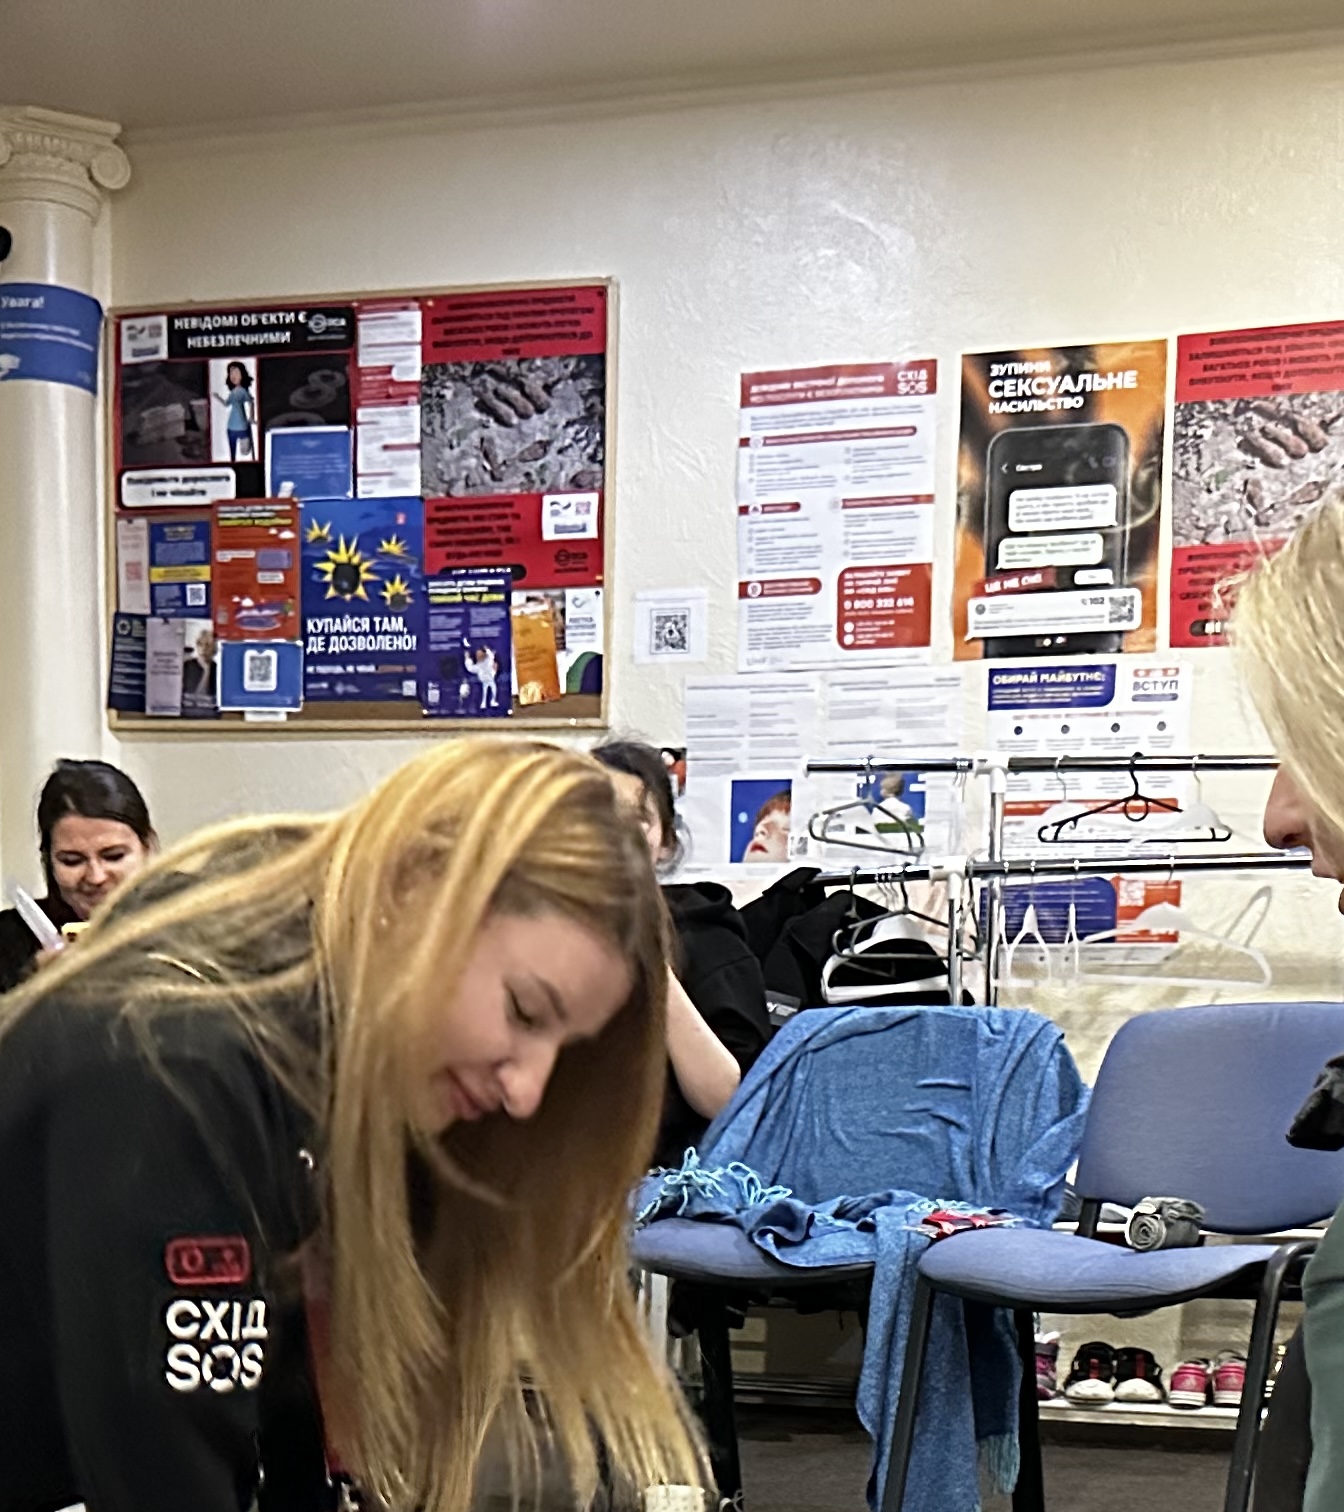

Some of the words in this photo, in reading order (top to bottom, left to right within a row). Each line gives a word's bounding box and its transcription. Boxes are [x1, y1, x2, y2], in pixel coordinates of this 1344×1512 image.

[174, 315, 238, 331] НЕВІДОМІ
[187, 331, 291, 349] НЕБЕЗПЕЧНИМИ
[990, 361, 1052, 377] ЗУПИНИ
[988, 370, 1139, 399] СЕКСУАЛЬНЕ
[988, 396, 1084, 415] НАСИЛЬСТВО
[306, 614, 370, 634] КУПАЙСЯ
[373, 616, 408, 635] ТАМ,
[306, 636, 326, 655] ДЕ
[328, 634, 417, 654] ДОЗВОЛЕНО!
[1133, 680, 1179, 691] ВСТУП
[165, 1299, 269, 1342] СХІД
[165, 1342, 264, 1393] SOS
